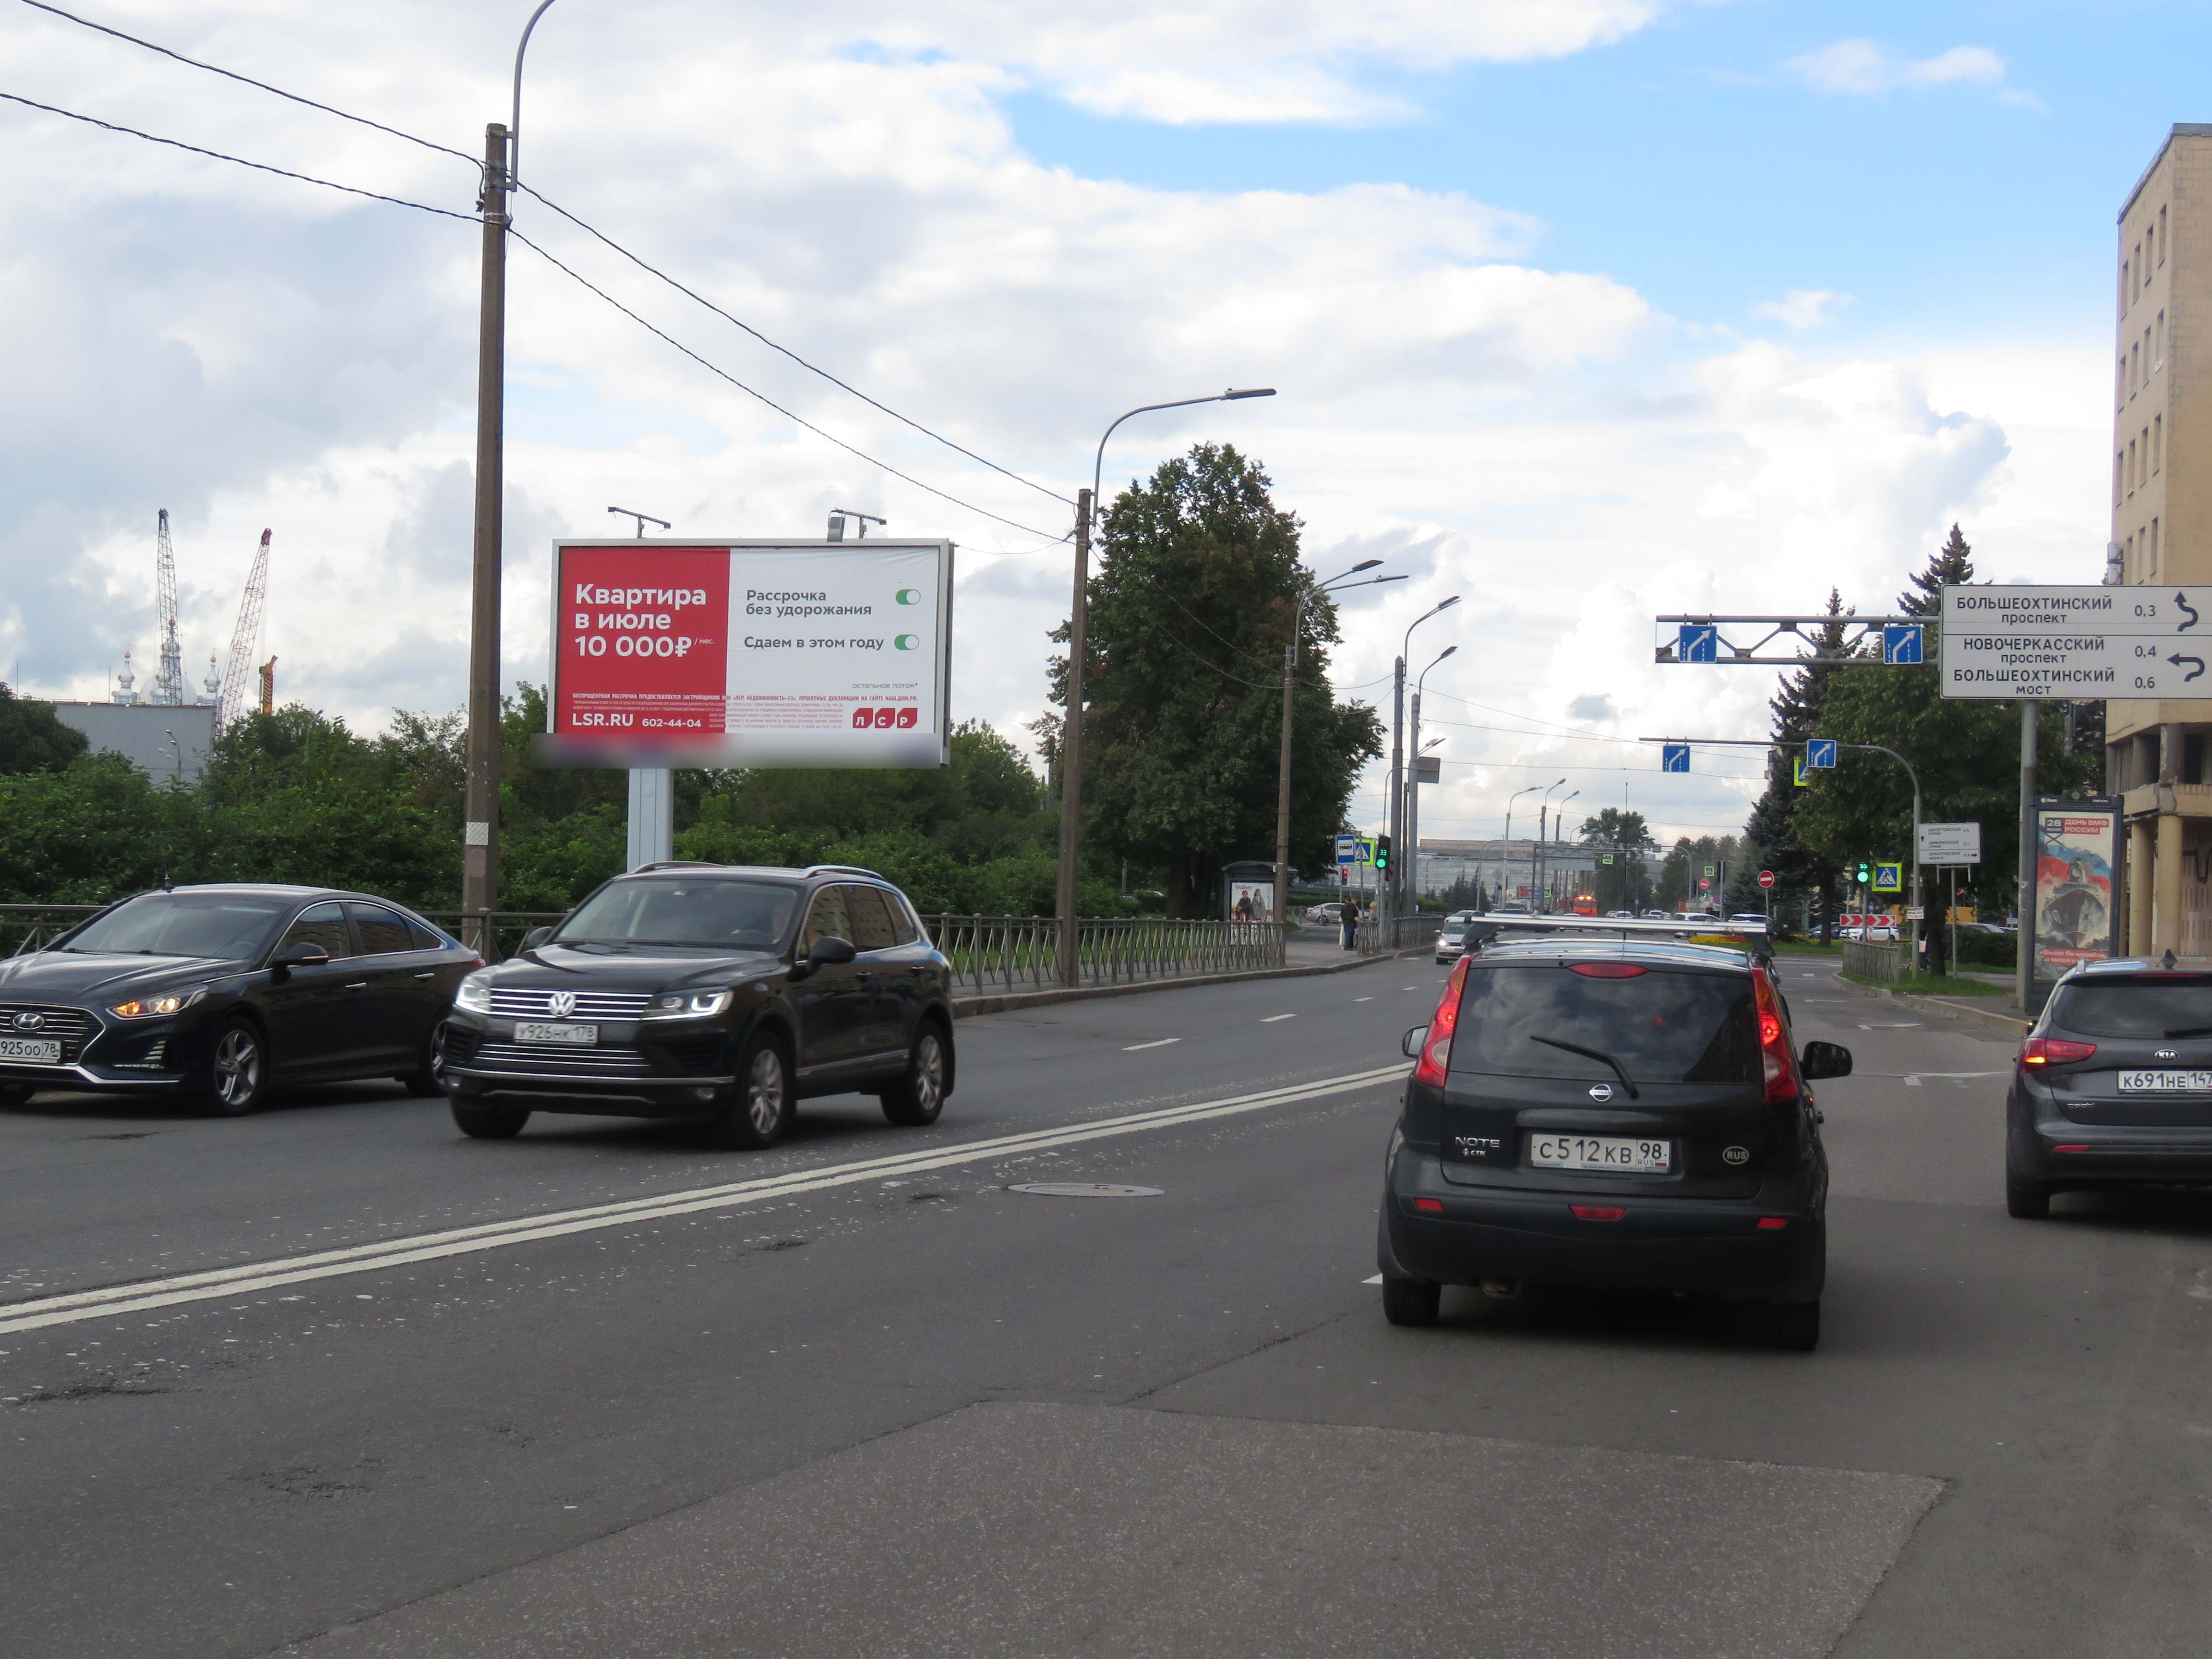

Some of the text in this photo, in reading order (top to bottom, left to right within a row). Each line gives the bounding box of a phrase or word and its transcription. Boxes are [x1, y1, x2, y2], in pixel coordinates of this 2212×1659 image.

[576, 583, 706, 610] Квартира
[747, 590, 826, 604] Рассрочка
[1957, 595, 2112, 610] БОЛЬШЕОХТИНСКИЙ
[746, 603, 871, 618] без удорожания
[2134, 605, 2156, 617] 0,3
[575, 613, 671, 629] в июле
[2002, 614, 2067, 625] проспект
[575, 635, 606, 657] 10
[744, 636, 884, 650] Сдаем в этом году
[1964, 636, 2104, 650] НОВОЧЕРКАССКИЙ
[2135, 646, 2156, 658] 0,4
[2001, 654, 2066, 665] проспект
[1954, 667, 2114, 682] БОЛЬШЕОХТИНСКИЙ
[2016, 685, 2051, 694] мост
[2135, 677, 2155, 689] 0,6
[572, 713, 633, 726] LSR.RU
[642, 719, 701, 727] 602-44-04
[44, 1042, 56, 1053] 78
[1455, 1136, 1500, 1148] NOTE
[1640, 1142, 1662, 1159] 98
[1727, 1151, 1746, 1159] RUS
